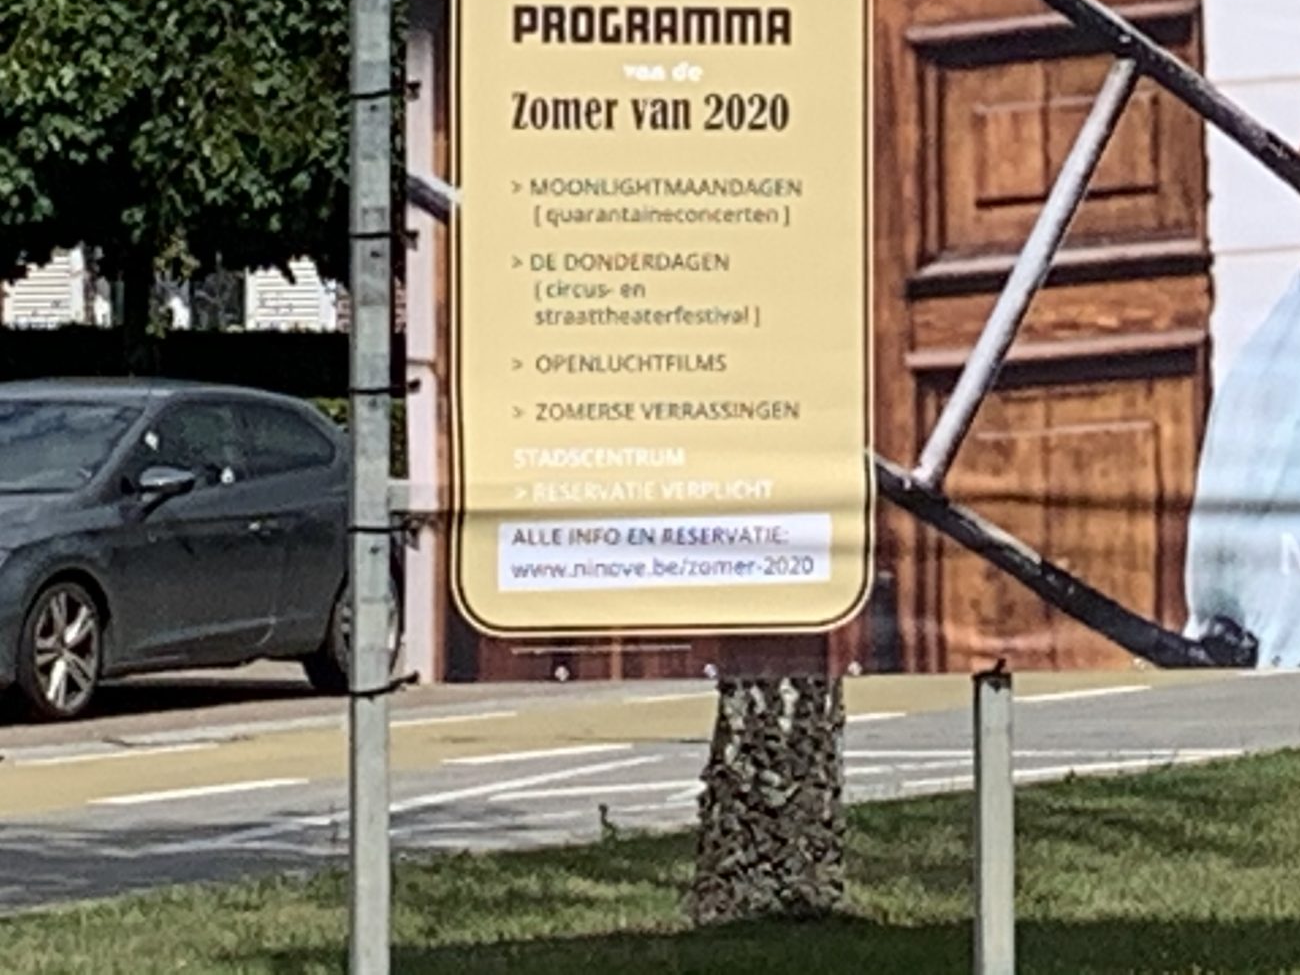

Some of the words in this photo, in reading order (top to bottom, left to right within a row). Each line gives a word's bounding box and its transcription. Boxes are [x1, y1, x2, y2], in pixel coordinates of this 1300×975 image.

[512, 4, 792, 45] PROGRAMMA
[622, 63, 666, 81] van
[671, 61, 703, 81] de
[511, 92, 618, 130] Zomer
[631, 97, 691, 130] van
[703, 93, 790, 132] 2020
[529, 177, 804, 198] MOONLIGHTMAANDAGEN
[545, 205, 779, 227] quarantaineconcerten
[529, 253, 557, 272] DE
[564, 252, 730, 272] DONDERDAGEN
[620, 283, 647, 299] en
[534, 305, 750, 326] straattheaterfestival
[535, 353, 728, 374] OPENLUCHTFILMS
[535, 402, 635, 421] ZOMERSE
[641, 401, 801, 421] VERRASSINGEN
[513, 446, 686, 469] STADSCENTRUM
[532, 481, 656, 504] RESERVATIE
[661, 478, 775, 501] VERPLICHT
[511, 527, 562, 546] ALLE
[568, 527, 621, 546] INFO
[627, 527, 655, 545] EN
[511, 555, 815, 579] www.ninove.be/zomer-2020
